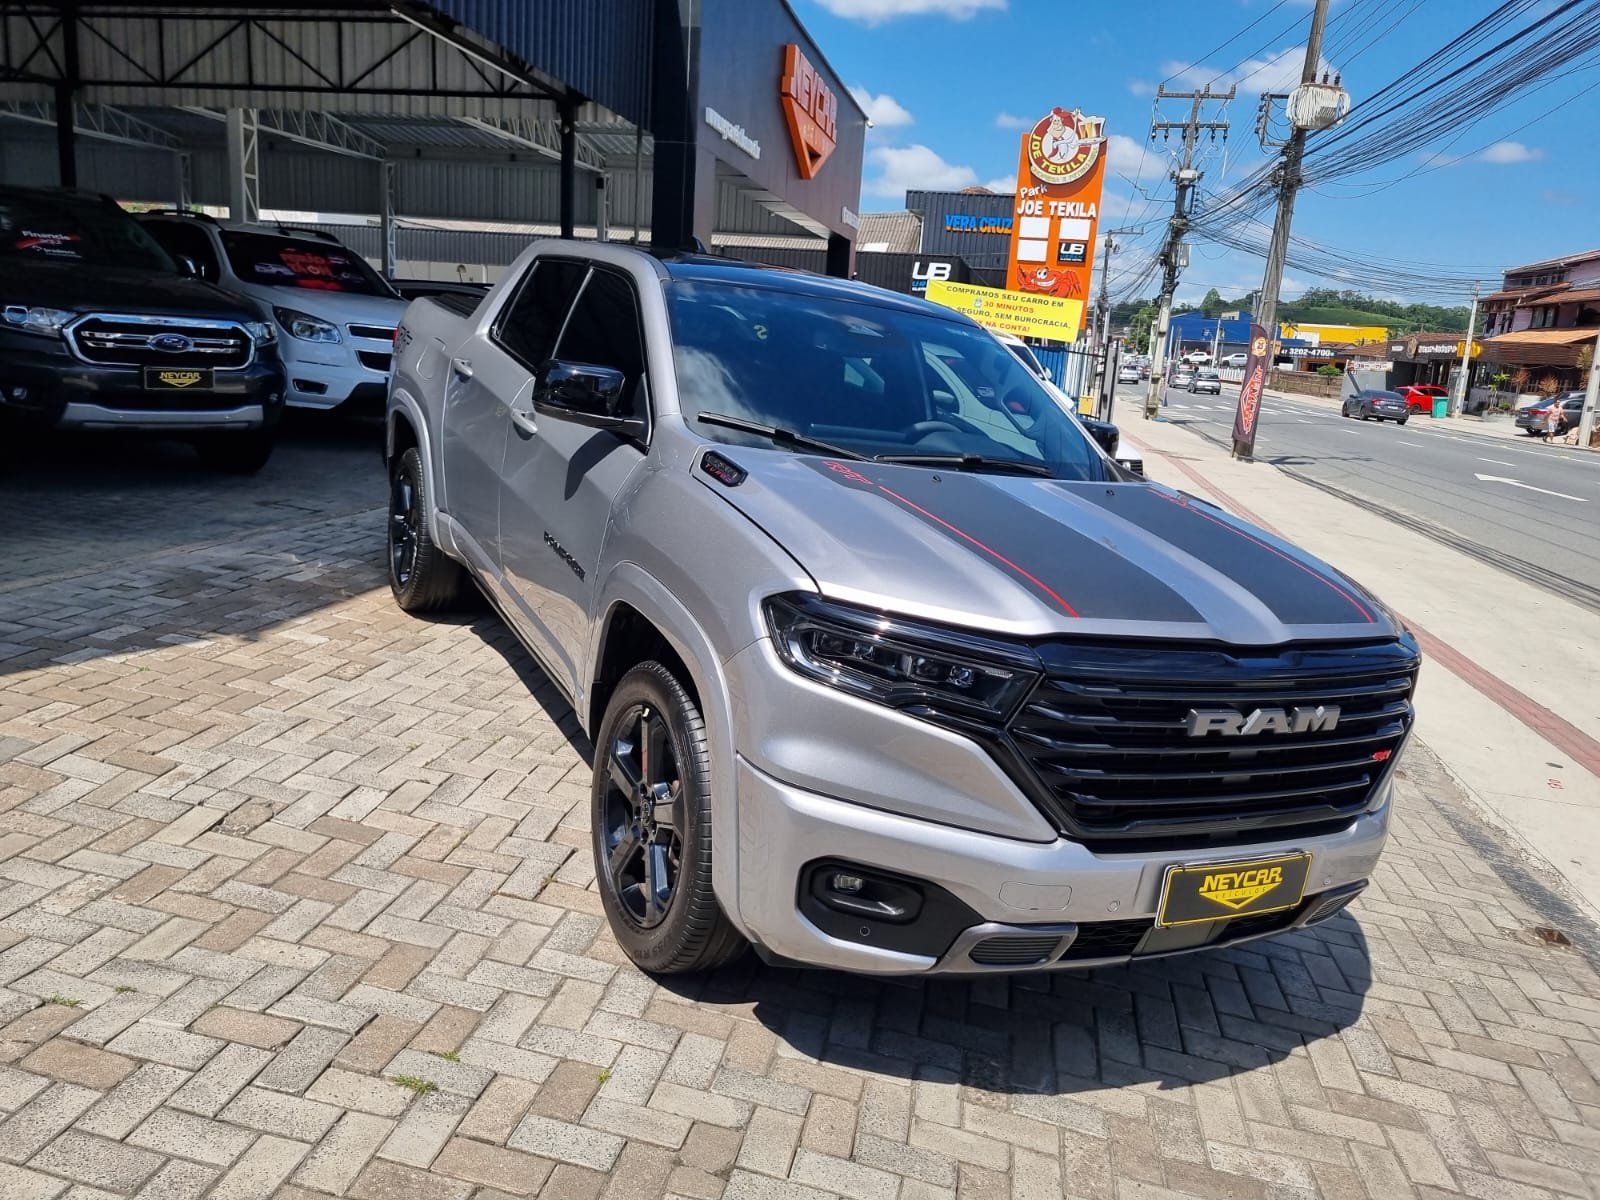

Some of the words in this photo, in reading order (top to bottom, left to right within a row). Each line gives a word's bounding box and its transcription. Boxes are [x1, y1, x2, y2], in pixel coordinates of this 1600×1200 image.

[785, 43, 837, 145] NEYCAR
[1031, 133, 1042, 160] JOE
[1041, 153, 1088, 174] TEKILA
[1020, 183, 1048, 198] Park
[1017, 199, 1044, 215] JOE
[1049, 200, 1097, 218] TEKILA
[945, 214, 977, 233] VERA
[978, 217, 1013, 234] CRUZ
[1060, 242, 1085, 255] UB
[912, 261, 952, 281] UB
[946, 285, 999, 299] COMPRAMOS
[1001, 293, 1018, 301] SEU
[1020, 296, 1049, 306] CARRO
[1051, 300, 1064, 308] EM
[984, 300, 994, 308] 30
[996, 302, 1035, 314] MINUTOS
[994, 312, 1012, 320] SEM
[1000, 322, 1030, 333] CONTA!
[1289, 347, 1331, 357] 3202-4700
[159, 371, 202, 380] NEYCAR
[1187, 704, 1341, 737] RAM
[1198, 866, 1283, 893] NEYCAR
